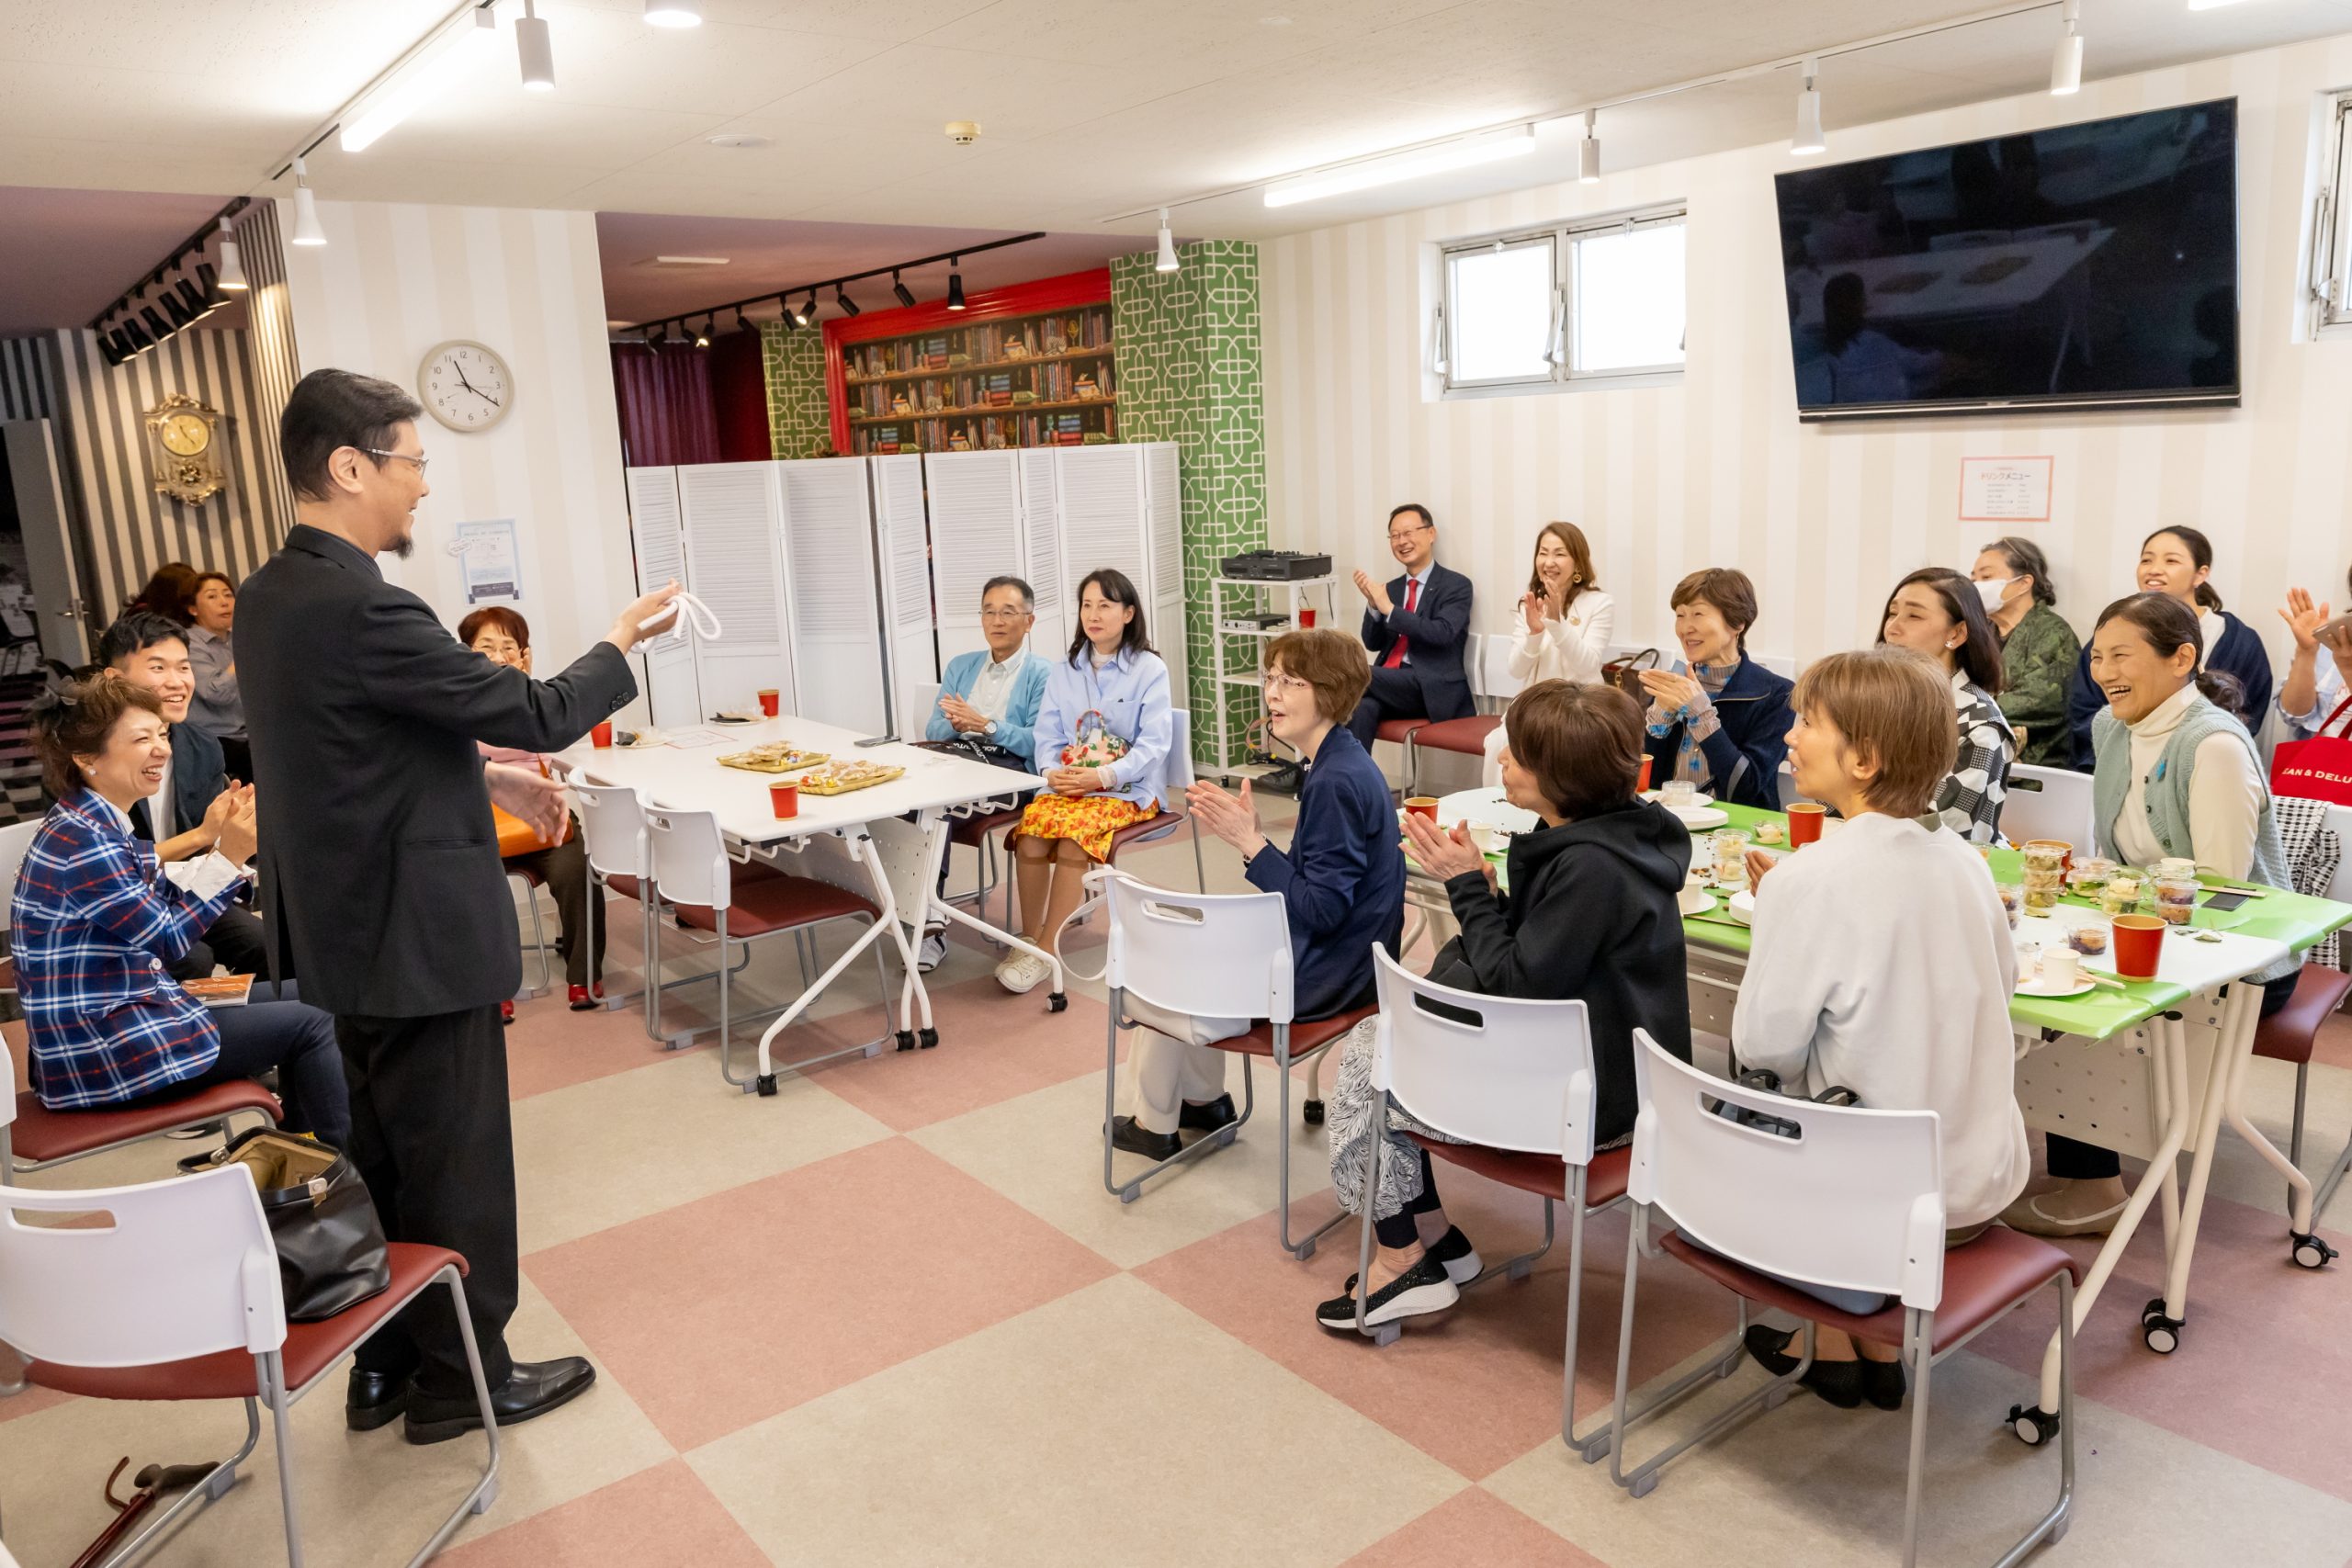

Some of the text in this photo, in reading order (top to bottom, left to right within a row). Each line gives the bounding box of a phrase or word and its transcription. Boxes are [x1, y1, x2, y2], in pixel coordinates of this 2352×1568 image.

[444, 355, 452, 363] 11
[459, 351, 468, 359] 12
[434, 367, 442, 375] 10
[489, 366, 494, 374] 2
[432, 382, 438, 390] 9
[1980, 472, 2031, 480] ドリンクメニュー
[2281, 768, 2352, 784] EAN & DELU
